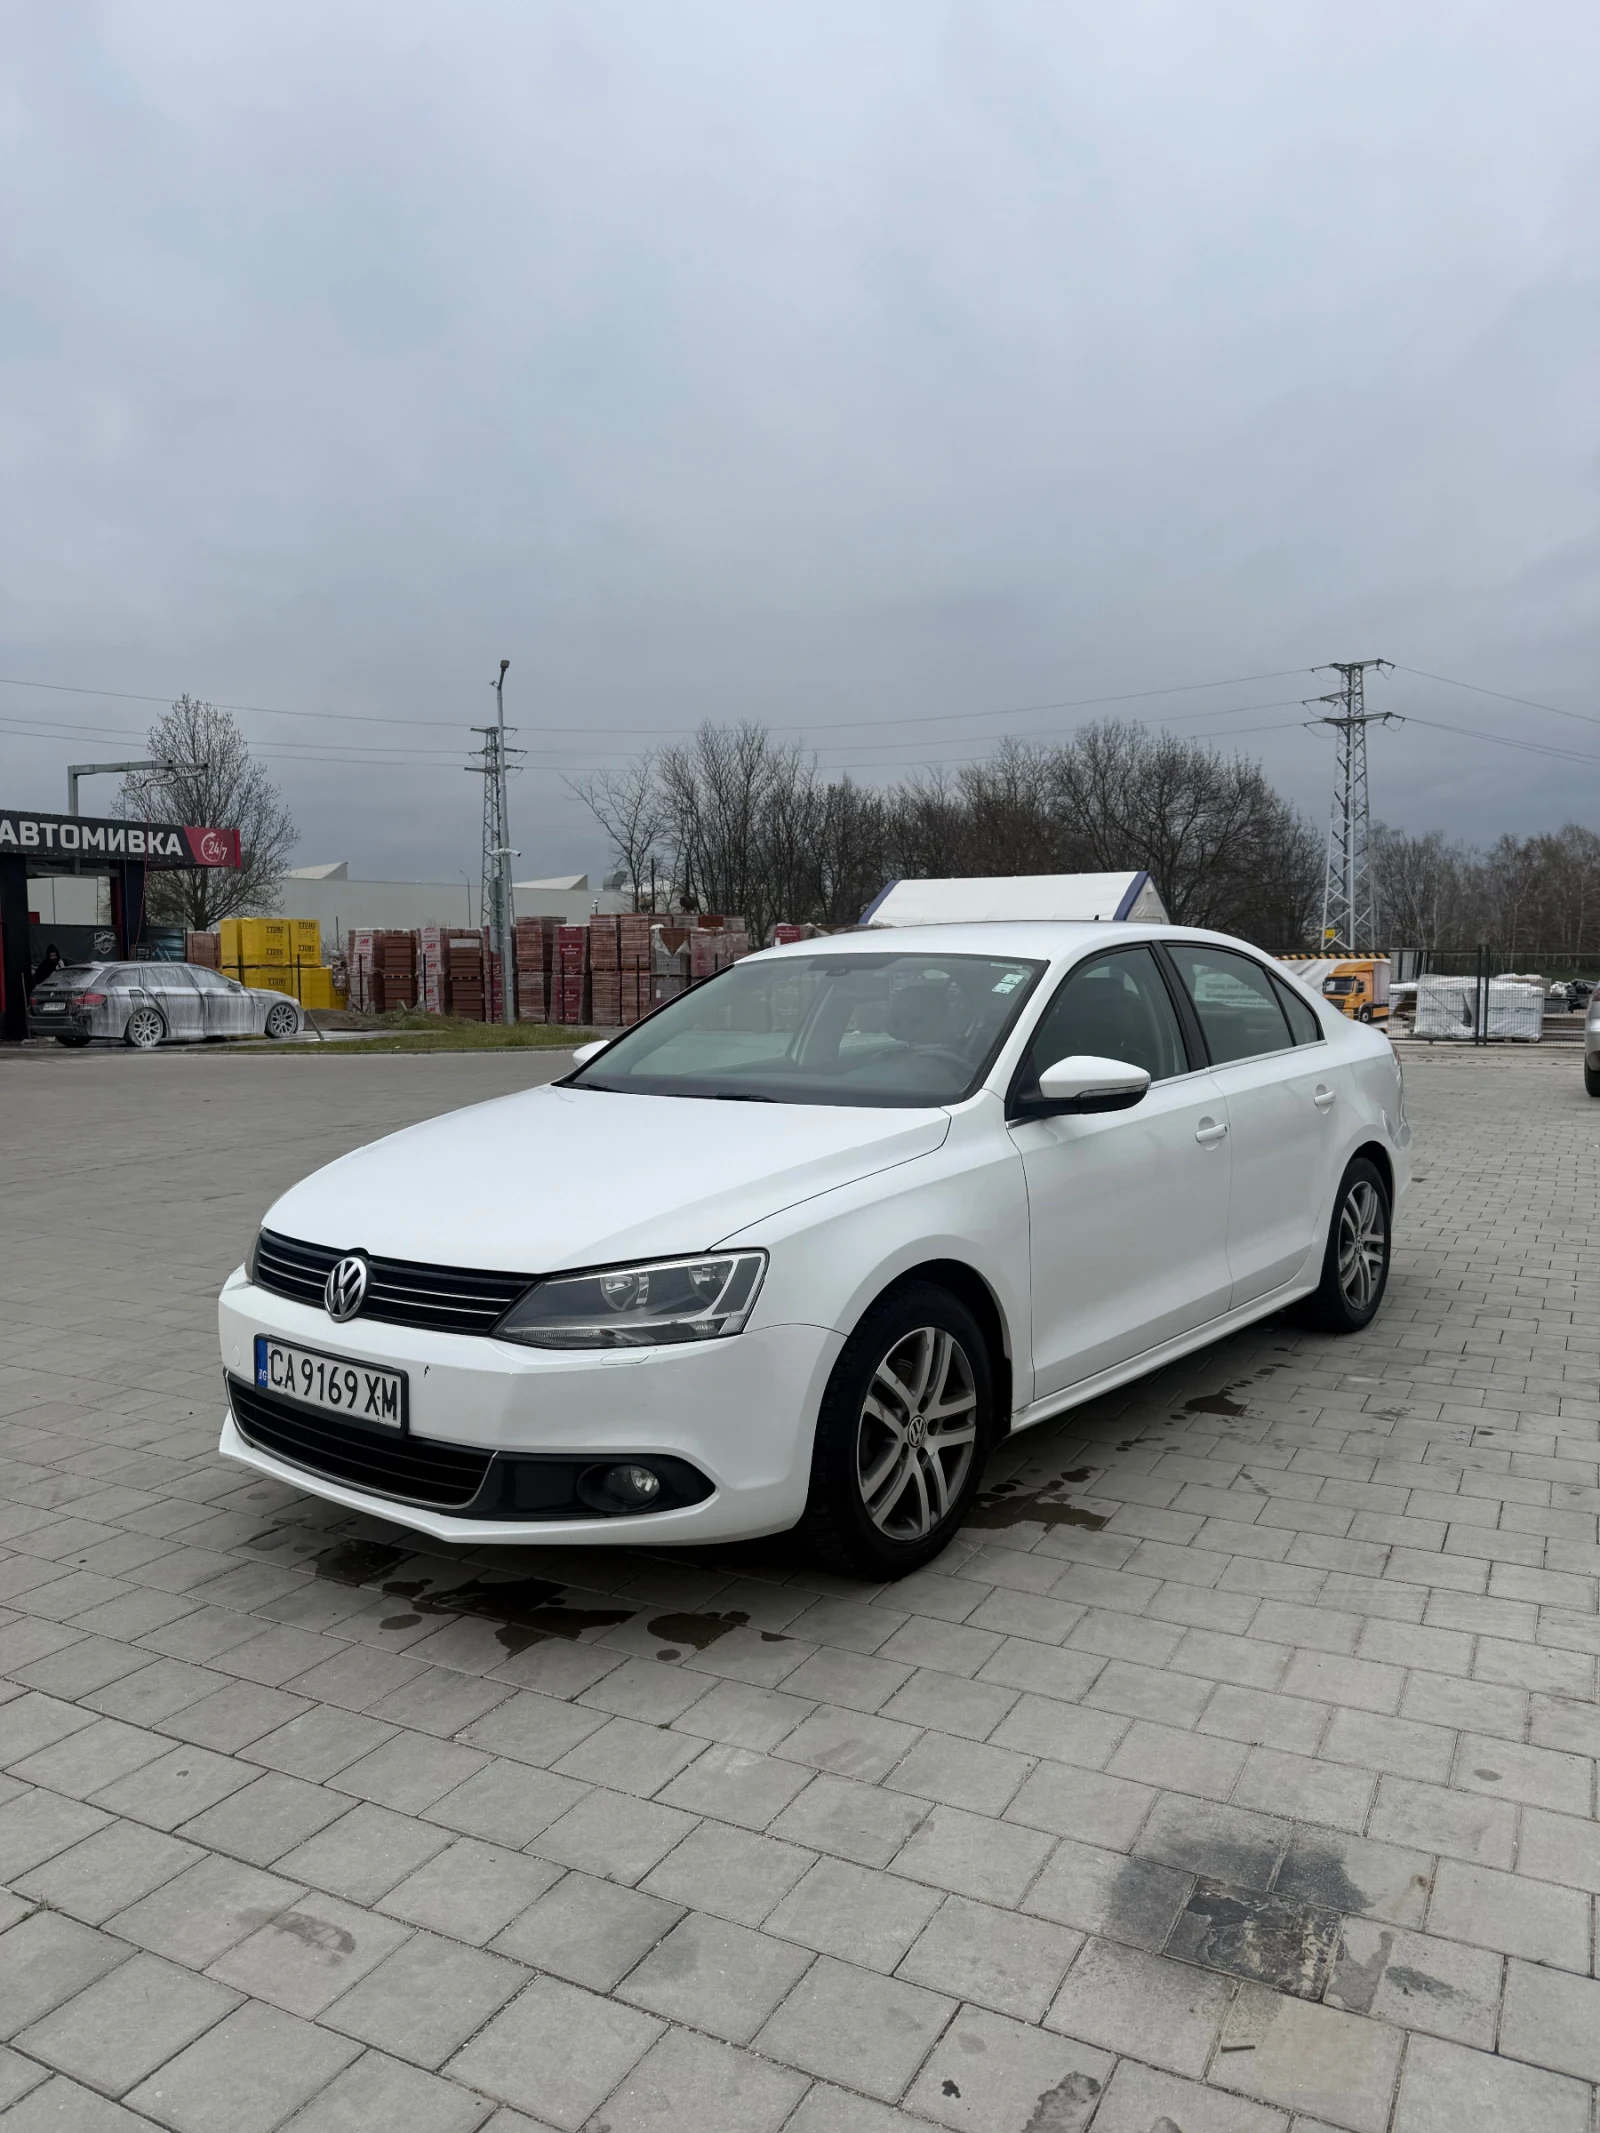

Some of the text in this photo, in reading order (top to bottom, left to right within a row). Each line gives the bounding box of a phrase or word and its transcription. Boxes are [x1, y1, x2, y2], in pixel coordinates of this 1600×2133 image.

[0, 819, 184, 856] АВТОМИВКА
[208, 841, 228, 860] 24/7
[269, 1348, 398, 1421] CA 9169 XM
